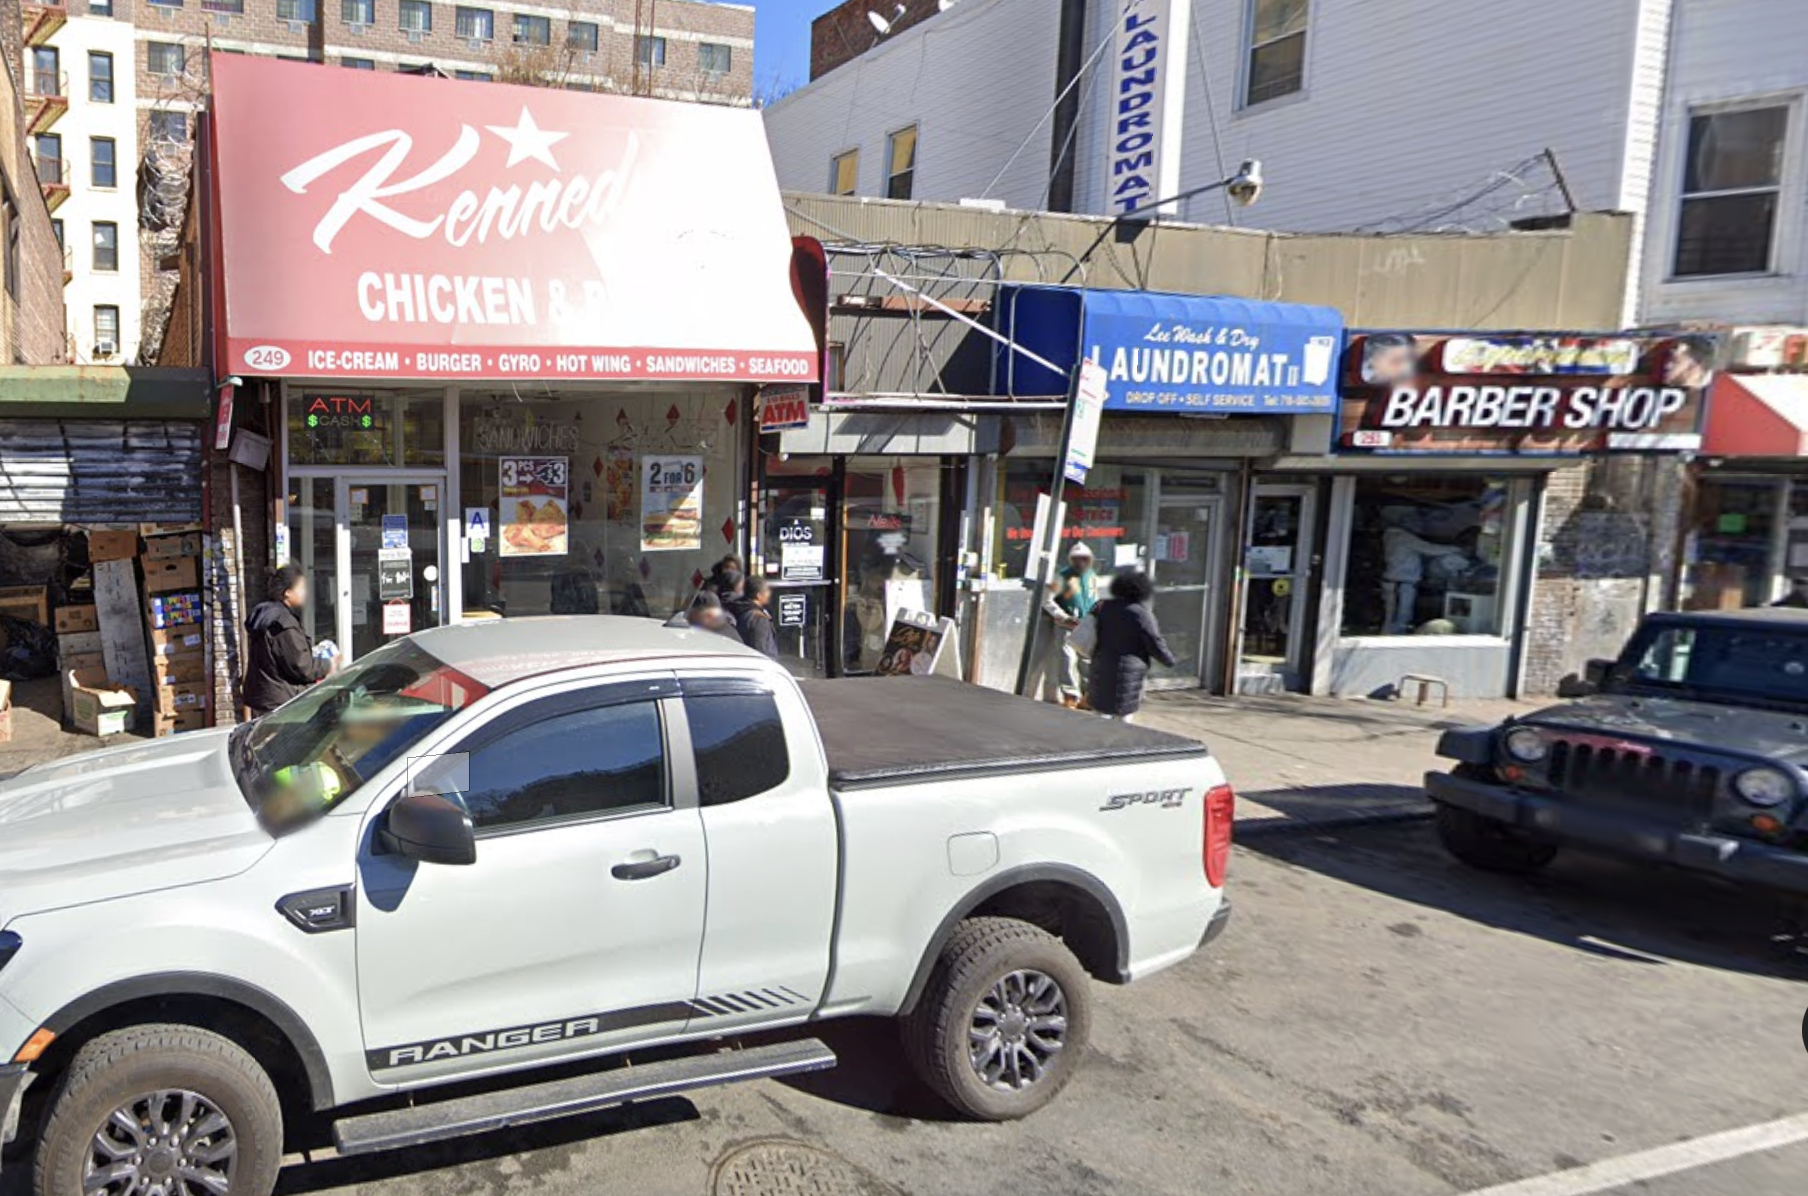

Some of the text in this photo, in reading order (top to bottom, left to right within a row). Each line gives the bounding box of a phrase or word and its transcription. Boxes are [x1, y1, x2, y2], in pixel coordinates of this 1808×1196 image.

[1113, 14, 1159, 212] LAUNDROMAT
[280, 123, 641, 254] Kenned
[357, 271, 537, 325] CHICKEN
[1144, 322, 1260, 351] Lee Wash & Dry
[252, 350, 285, 366] 249
[307, 350, 809, 375] ICE-CREAM BURGER GYRO HOT WING SANDWICHES SEAFOOD
[308, 396, 372, 413] ATM
[1125, 391, 1156, 405] DROP
[1158, 392, 1177, 405] OFF
[1185, 393, 1211, 406] SELF
[1213, 394, 1255, 407] SERVICE
[1381, 385, 1688, 429] BARBER SHOP
[761, 400, 807, 425] ATM
[502, 460, 518, 487] 3
[517, 460, 535, 471] PCS
[650, 461, 661, 484] 2
[664, 471, 682, 484] FOR
[471, 511, 485, 529] A
[779, 525, 813, 541] DIOS
[1098, 786, 1194, 812] SPORT
[388, 1017, 600, 1067] RANGER
